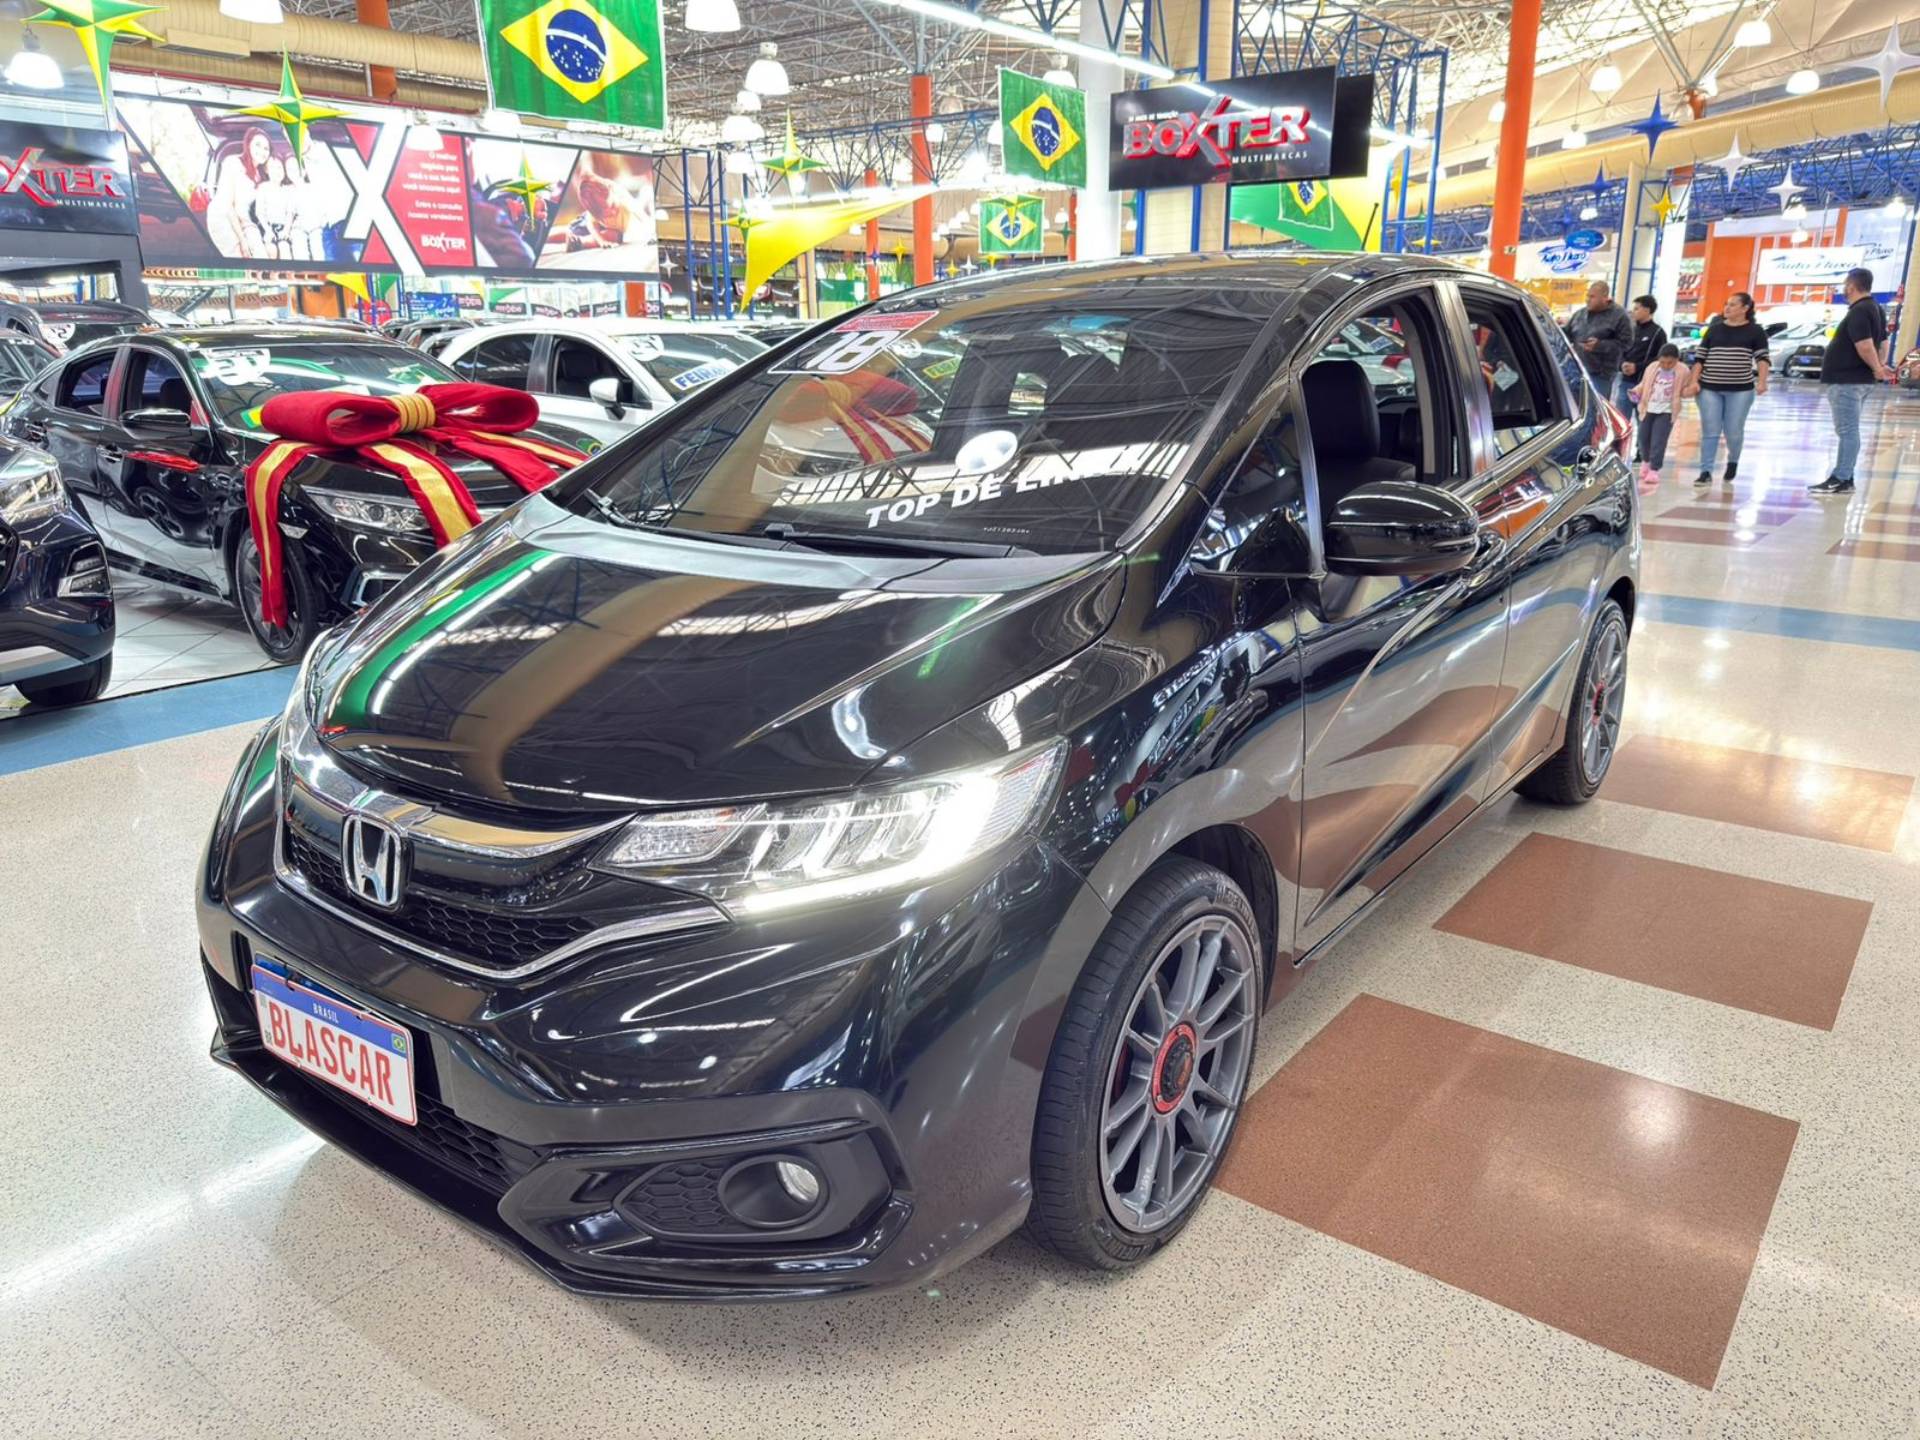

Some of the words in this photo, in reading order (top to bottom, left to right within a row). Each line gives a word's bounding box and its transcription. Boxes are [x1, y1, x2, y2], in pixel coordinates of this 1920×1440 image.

[1123, 95, 1312, 168] BOXTER
[1232, 151, 1308, 164] MULTIMARCAS
[56, 198, 126, 209] MULTIMARCAS
[421, 232, 467, 253] BOXTER
[804, 330, 901, 371] 18
[865, 493, 942, 529] TOP
[951, 475, 1011, 508] DE
[312, 1002, 339, 1024] BRASIL
[269, 1001, 395, 1106] BLASCAR
